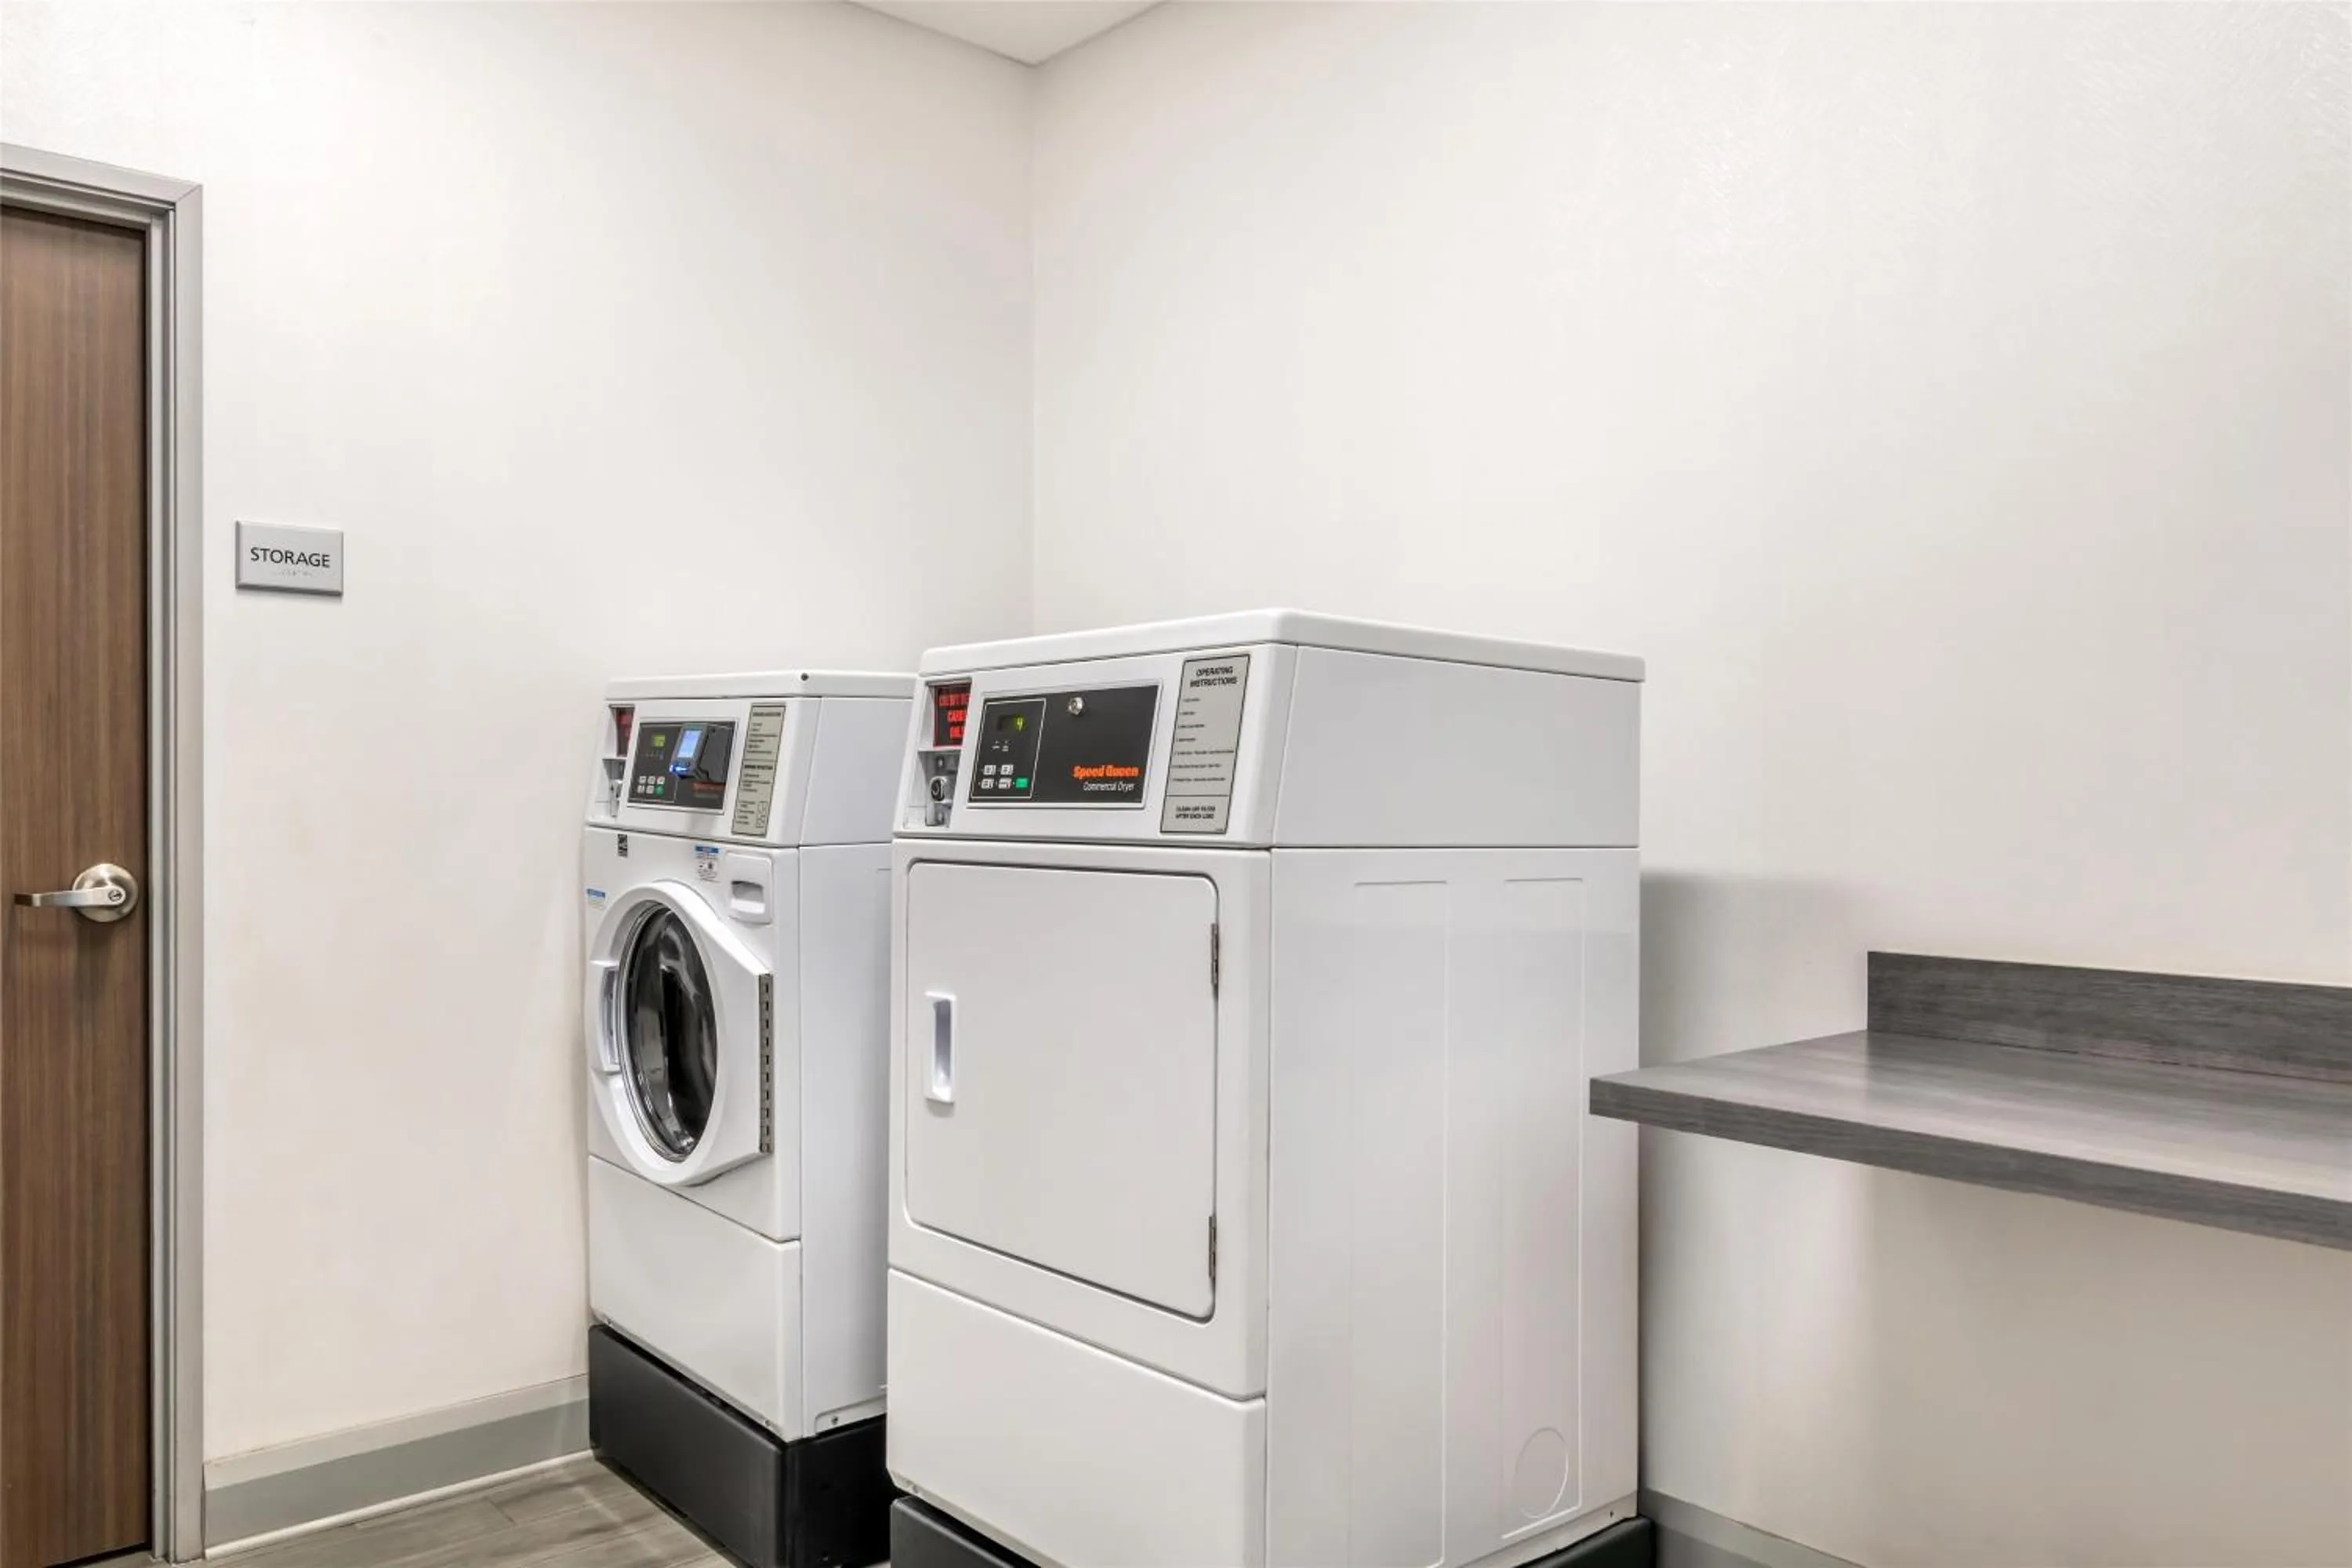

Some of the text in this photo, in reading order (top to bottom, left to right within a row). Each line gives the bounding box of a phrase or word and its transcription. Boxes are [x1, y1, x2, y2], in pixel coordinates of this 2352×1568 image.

[250, 546, 330, 568] STORAGE
[1196, 666, 1233, 677] OPERATING
[1189, 677, 1237, 688] INSTRUCTIONS
[1073, 764, 1139, 780] Speed Queen
[1083, 781, 1135, 793] Commercial Dryer
